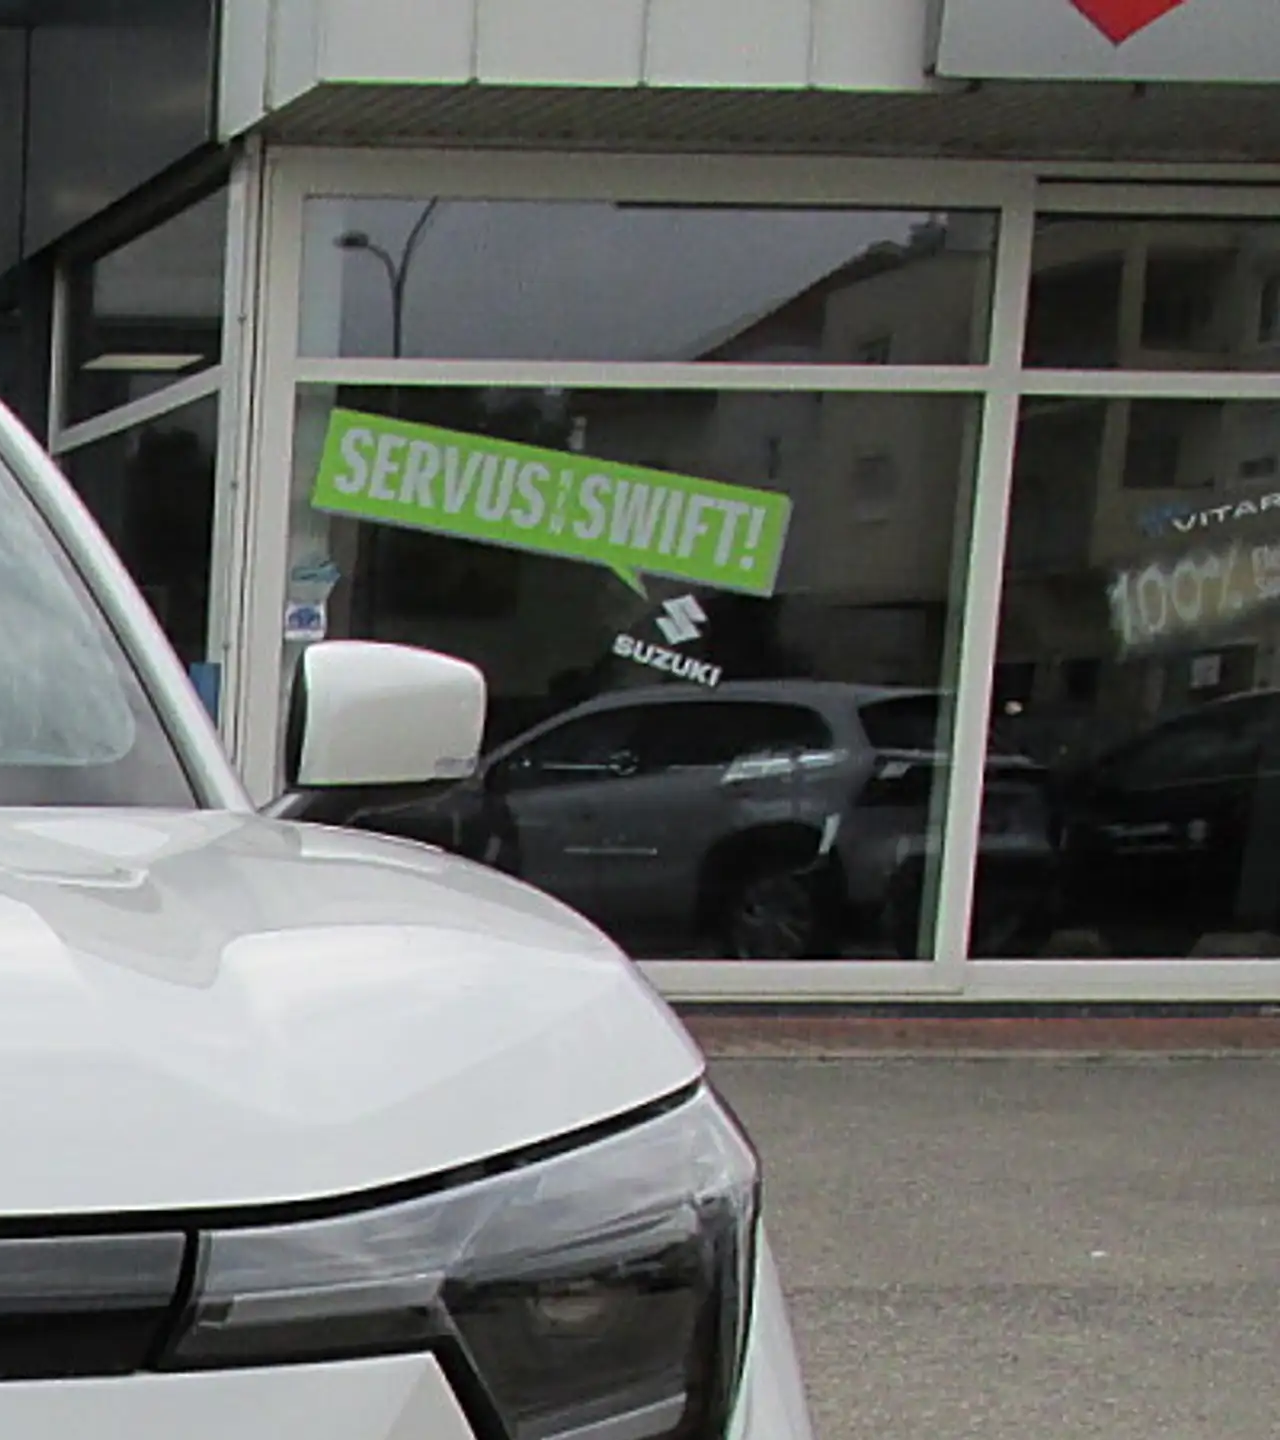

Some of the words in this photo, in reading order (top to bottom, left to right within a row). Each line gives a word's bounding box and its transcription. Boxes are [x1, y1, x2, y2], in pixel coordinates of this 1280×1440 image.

[333, 428, 550, 532] SERVUS
[572, 472, 767, 571] SWIFT!
[613, 633, 722, 688] SUZUKI
